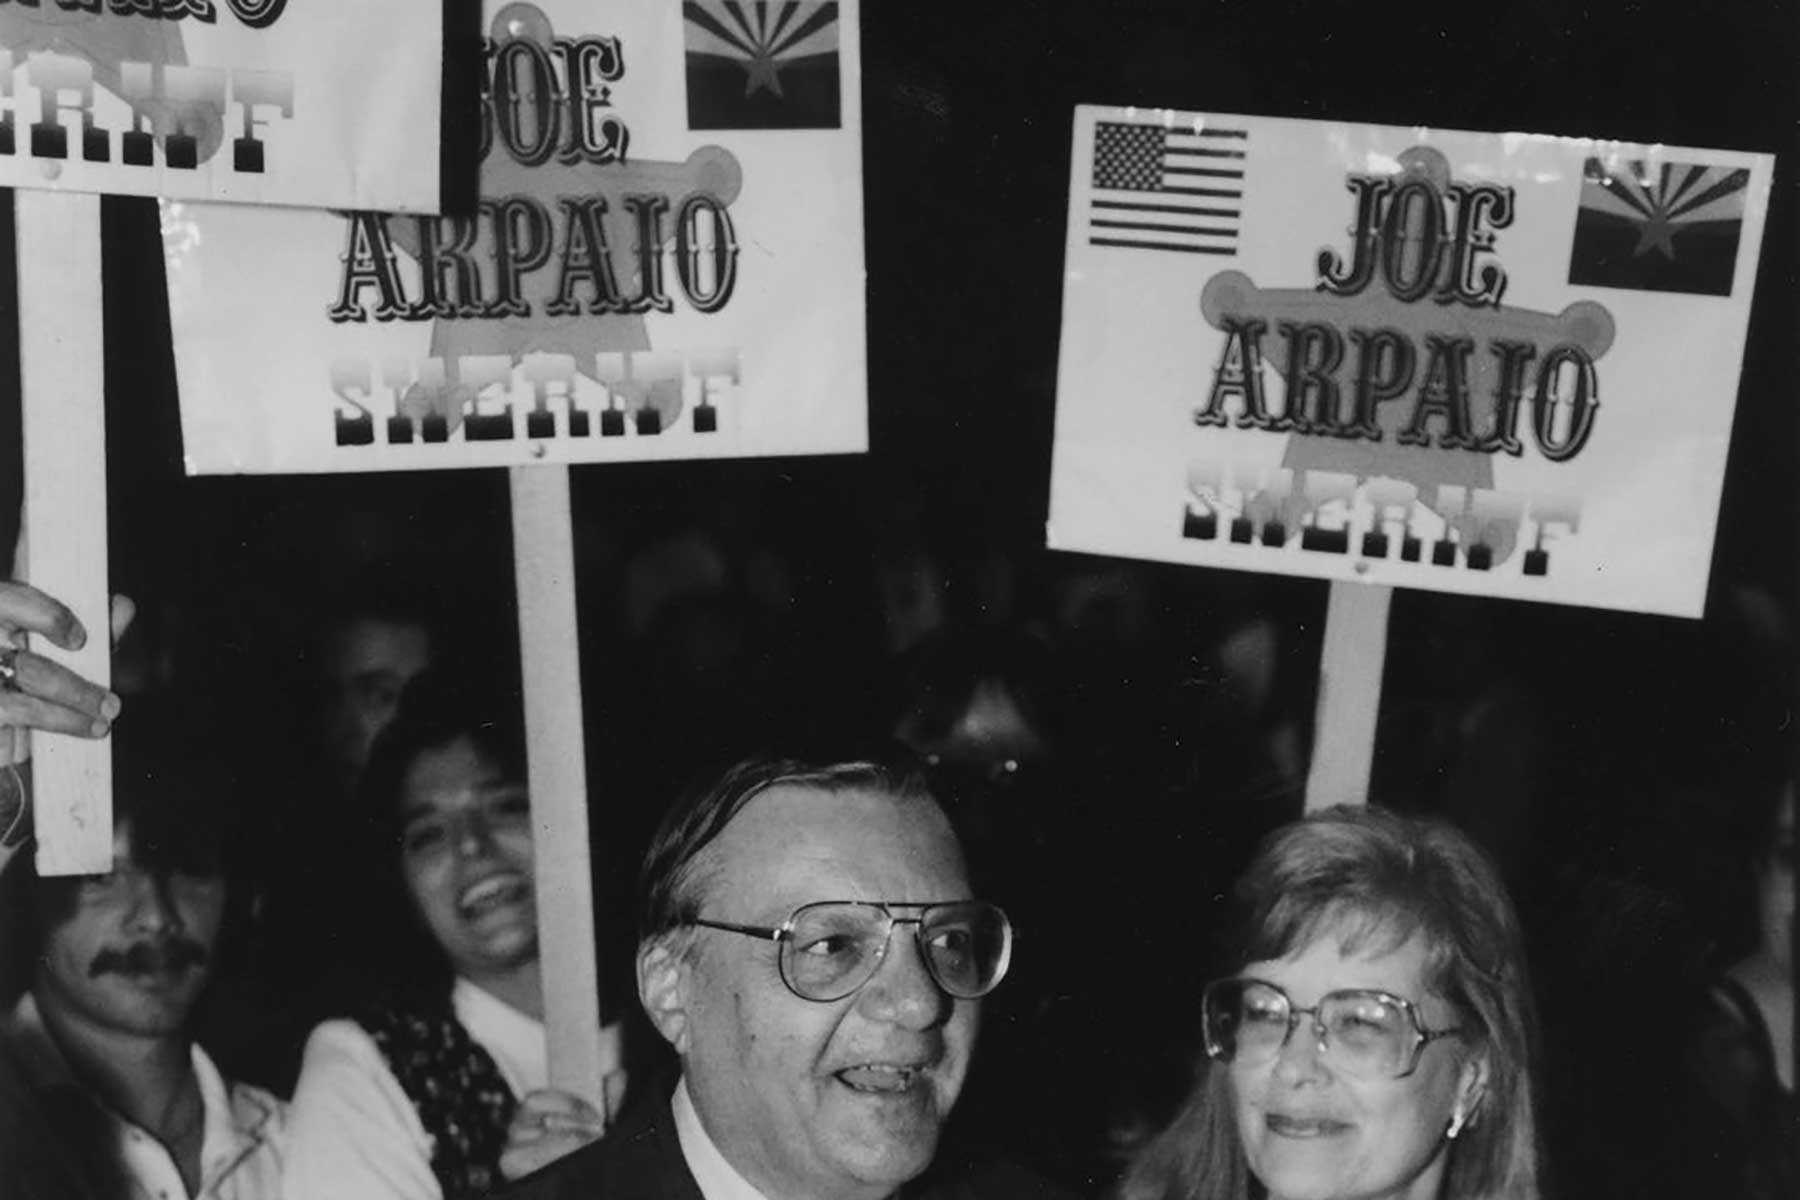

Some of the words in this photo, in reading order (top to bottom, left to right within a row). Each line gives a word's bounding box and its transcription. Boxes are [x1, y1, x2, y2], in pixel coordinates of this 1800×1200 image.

[481, 35, 629, 167] OE
[327, 193, 741, 324] ARPAIO
[1314, 174, 1515, 307] JOE
[1193, 314, 1601, 463] ARPAIO
[1183, 460, 1584, 577] SHERIFF
